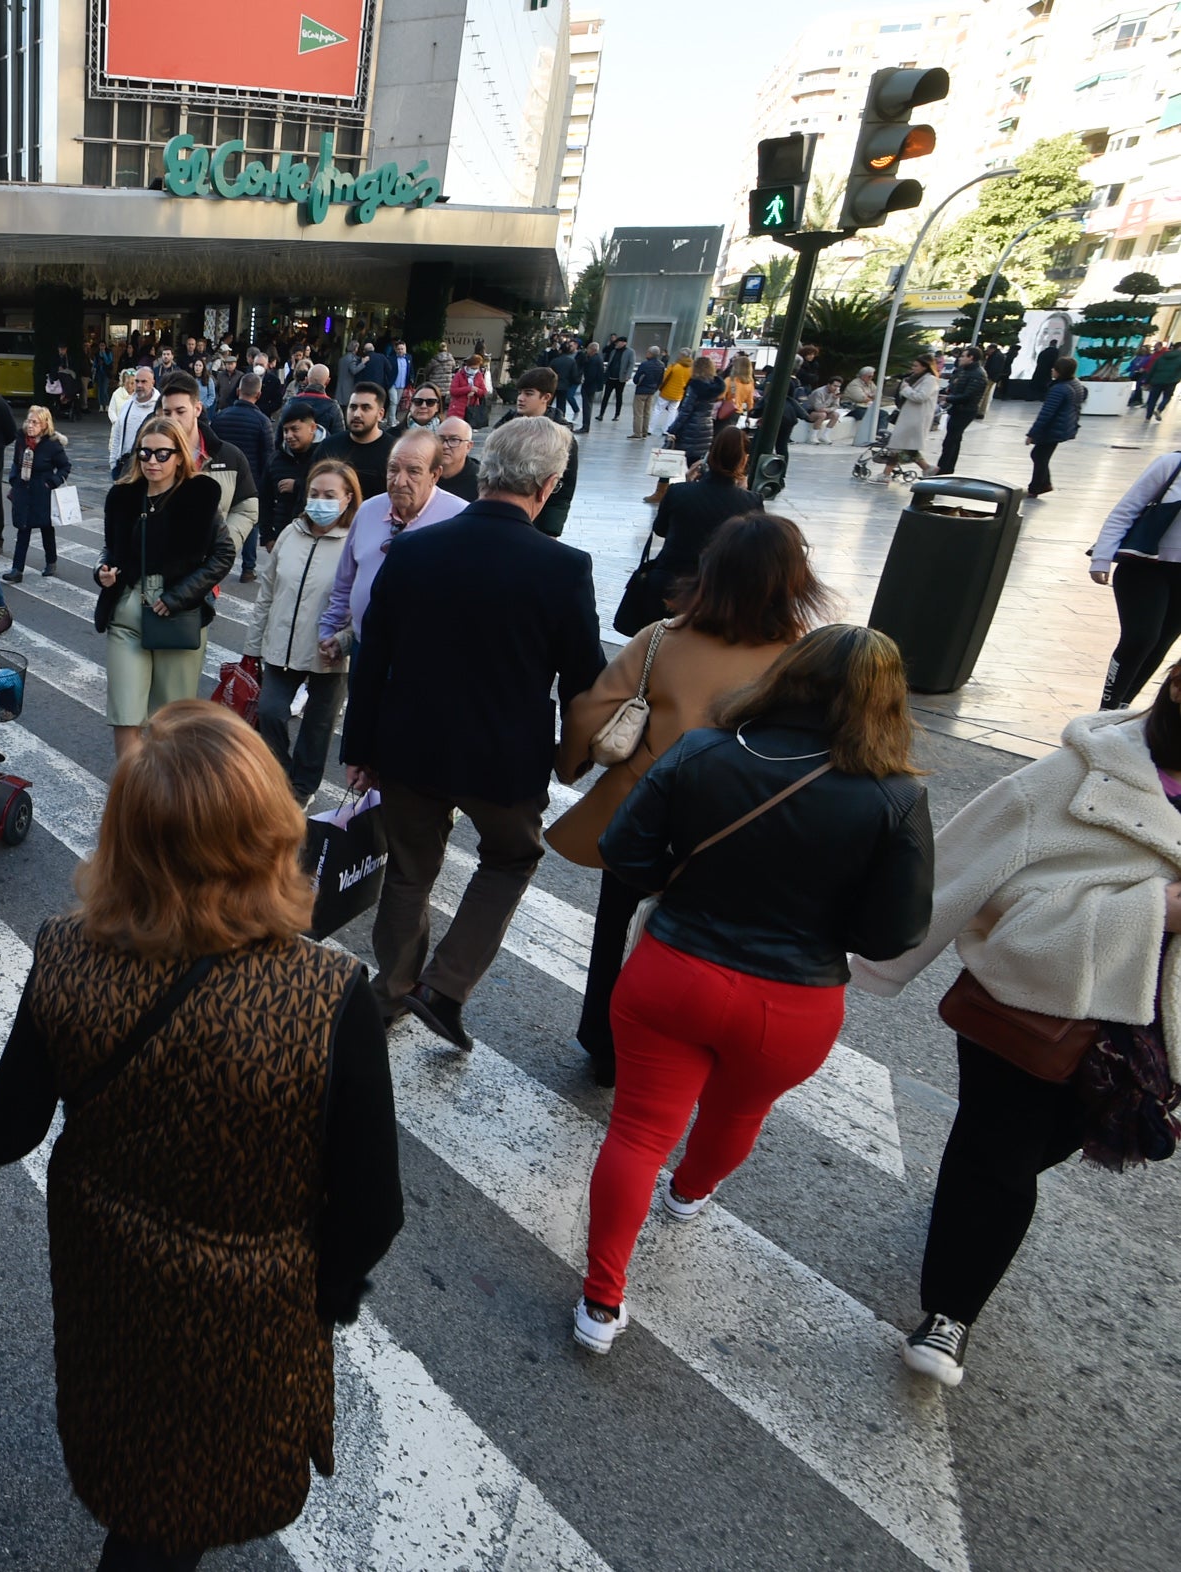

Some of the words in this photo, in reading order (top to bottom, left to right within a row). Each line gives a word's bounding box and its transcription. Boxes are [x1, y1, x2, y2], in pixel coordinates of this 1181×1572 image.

[163, 133, 210, 196] El
[210, 139, 310, 202] Corte
[339, 858, 365, 892] Vidal
